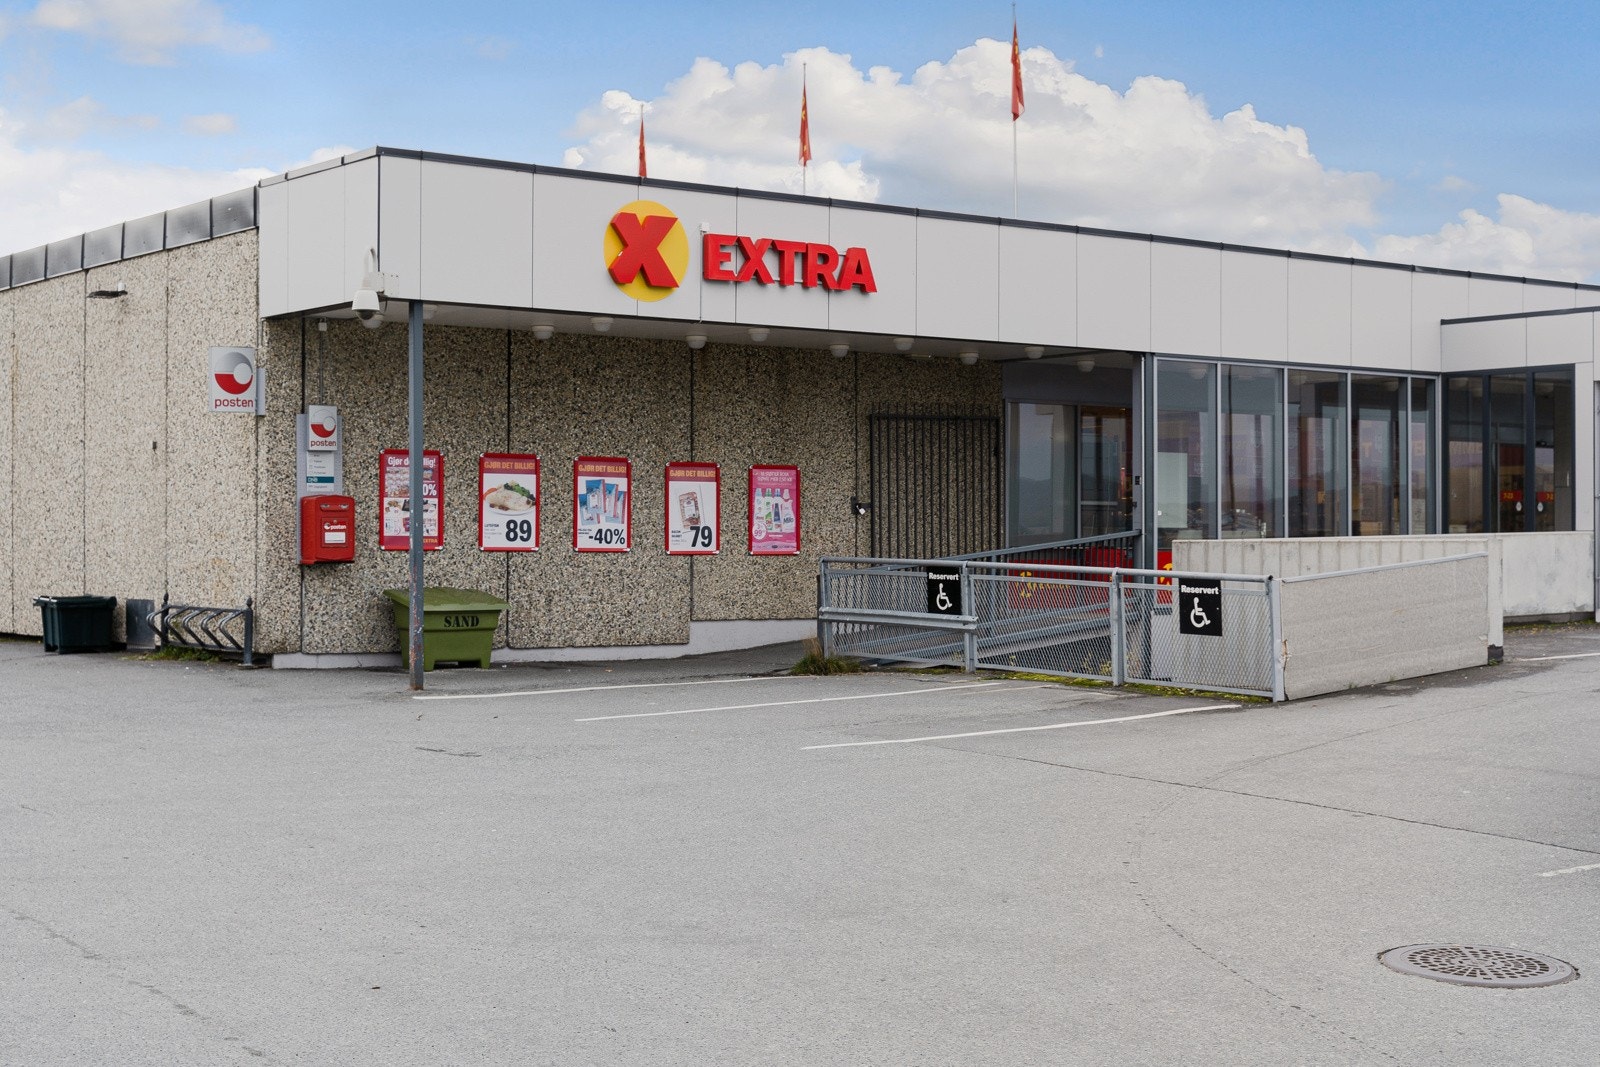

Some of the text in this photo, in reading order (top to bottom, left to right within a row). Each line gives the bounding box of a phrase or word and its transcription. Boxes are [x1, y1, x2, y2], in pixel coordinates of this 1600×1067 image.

[703, 233, 877, 293] EXTRA
[214, 397, 254, 409] posten
[310, 439, 337, 448] posten
[388, 456, 402, 466] Gjør
[423, 458, 436, 468] llig!
[423, 483, 437, 496] 0%
[505, 519, 532, 542] 89
[588, 528, 626, 544] -40%
[690, 526, 712, 548] 79
[928, 572, 959, 581] Reservert
[1181, 584, 1219, 595] Reservert
[444, 615, 480, 628] SAND
